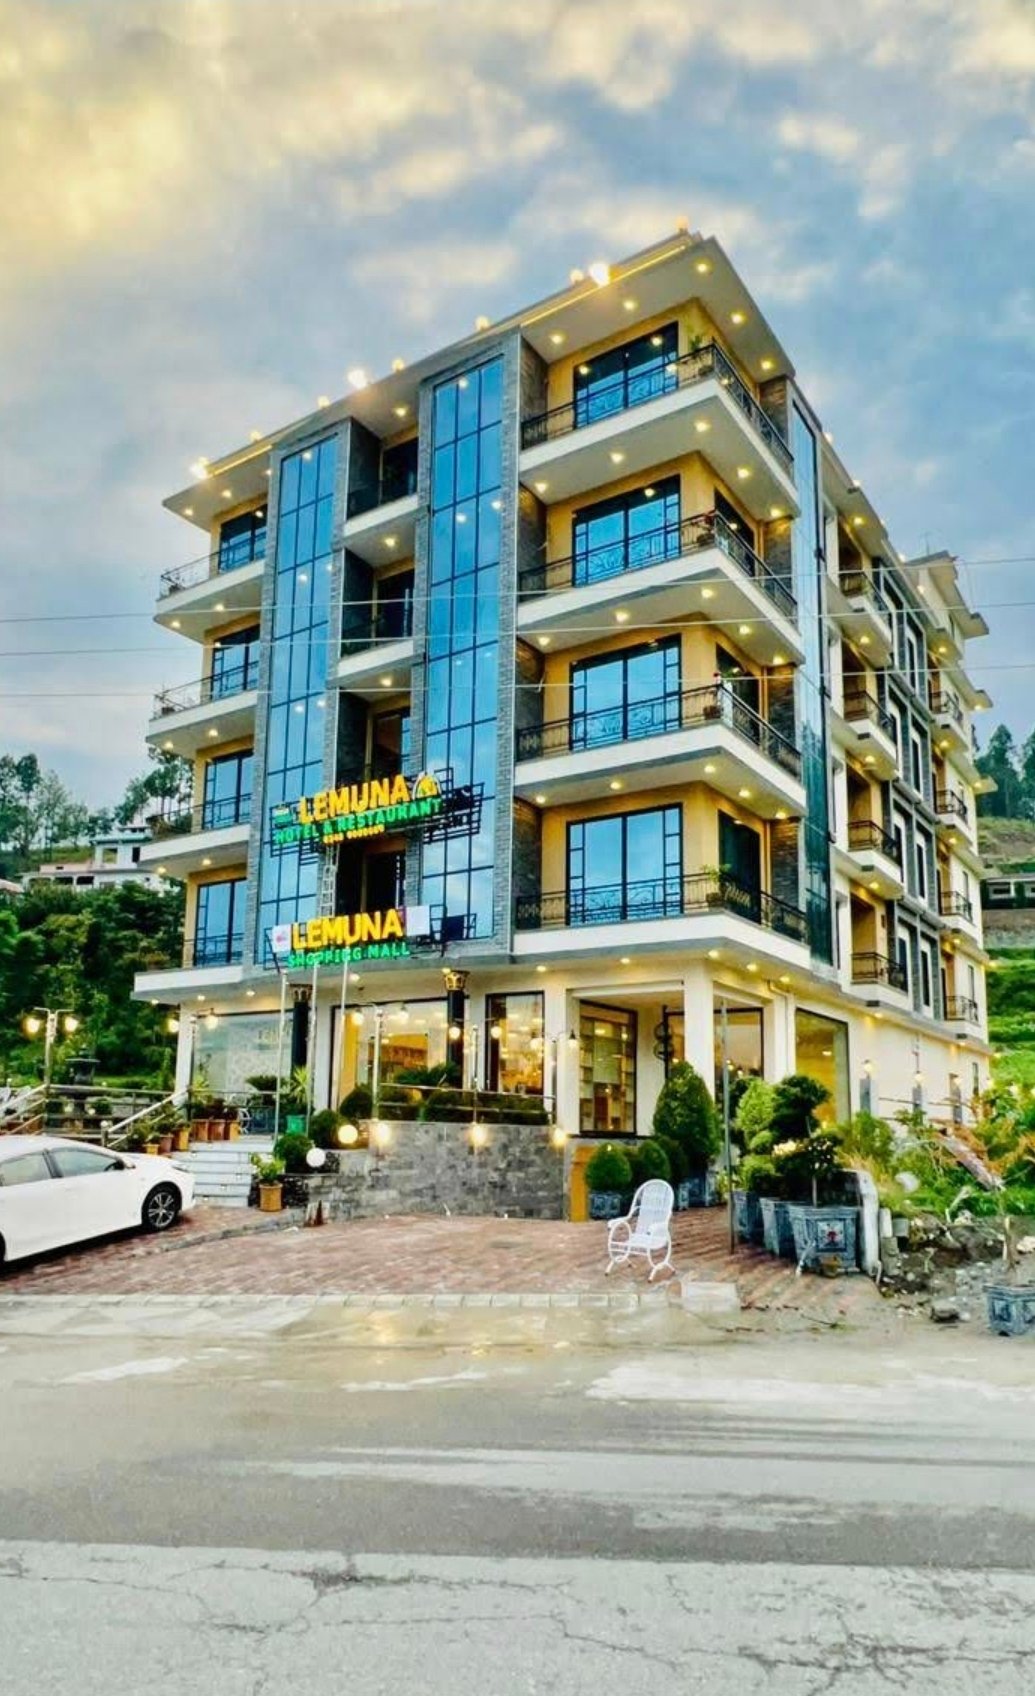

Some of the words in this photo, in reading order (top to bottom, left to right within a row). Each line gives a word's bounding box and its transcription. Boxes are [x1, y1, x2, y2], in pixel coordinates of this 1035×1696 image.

[298, 774, 410, 824] LEMUNA
[275, 825, 319, 842] HOTEL
[323, 821, 334, 835] &
[338, 799, 442, 831] RESTAURANT
[292, 908, 404, 950] LEMUNA
[368, 942, 410, 958] MALL
